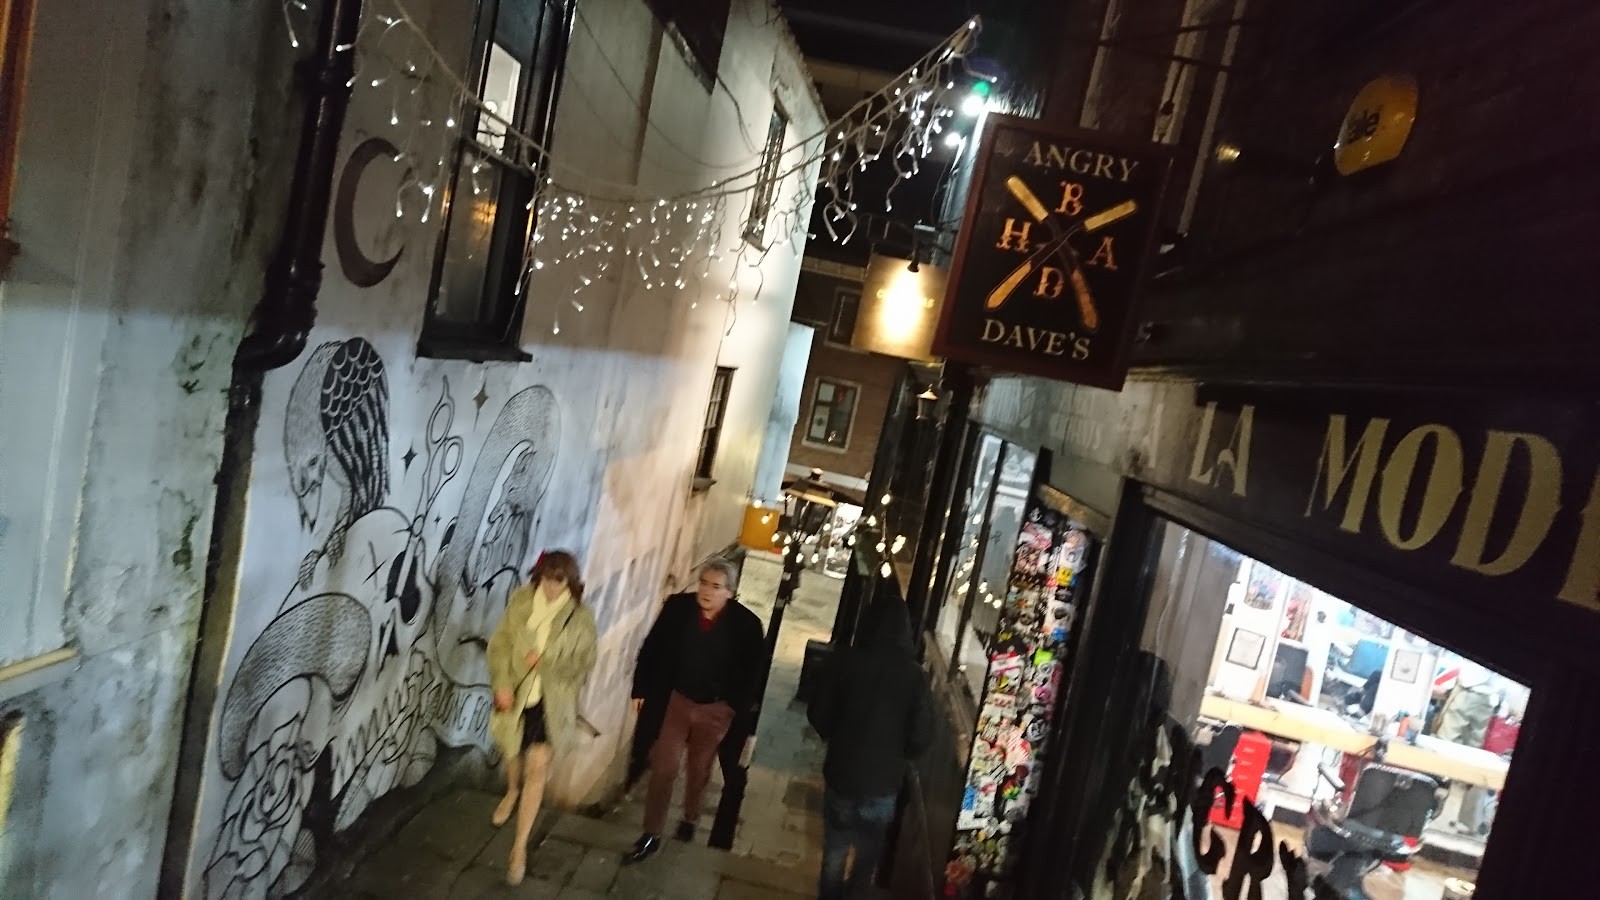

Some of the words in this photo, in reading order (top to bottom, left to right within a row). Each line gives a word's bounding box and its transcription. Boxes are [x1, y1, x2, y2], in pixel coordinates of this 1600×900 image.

[1023, 141, 1140, 184] ANGRY
[1055, 180, 1084, 217] B
[996, 217, 1033, 253] H
[1086, 235, 1119, 271] A
[1033, 266, 1065, 299] D
[980, 319, 1092, 361] DAVE'S
[1187, 401, 1255, 496] LA
